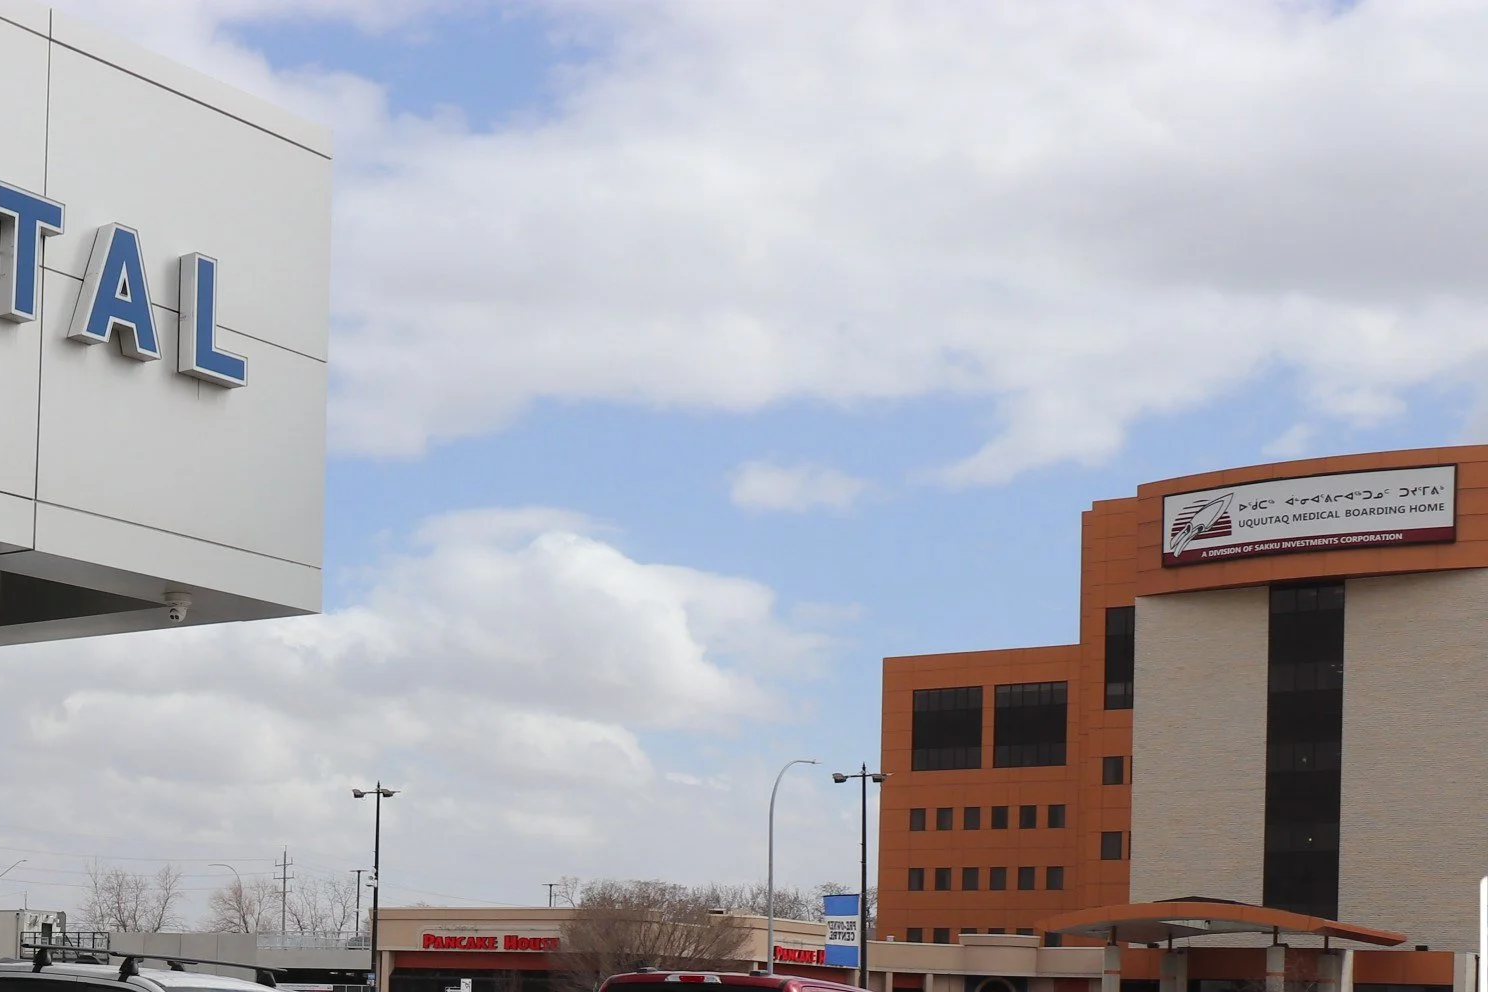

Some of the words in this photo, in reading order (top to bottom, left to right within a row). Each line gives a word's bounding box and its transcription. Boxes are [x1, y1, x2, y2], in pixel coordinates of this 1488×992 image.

[1238, 514, 1290, 528] UQUUTAQ
[1293, 510, 1340, 522] MEDICAL
[1345, 505, 1406, 517] BOARDING
[1409, 502, 1445, 512] HOME
[1208, 547, 1242, 557] DIVISION
[1243, 545, 1253, 553] OF
[1254, 543, 1281, 551] SAKKU
[1282, 537, 1339, 548] INVESTMENTS
[1340, 533, 1403, 543] CORPORATION
[422, 933, 498, 949] PANCAKE
